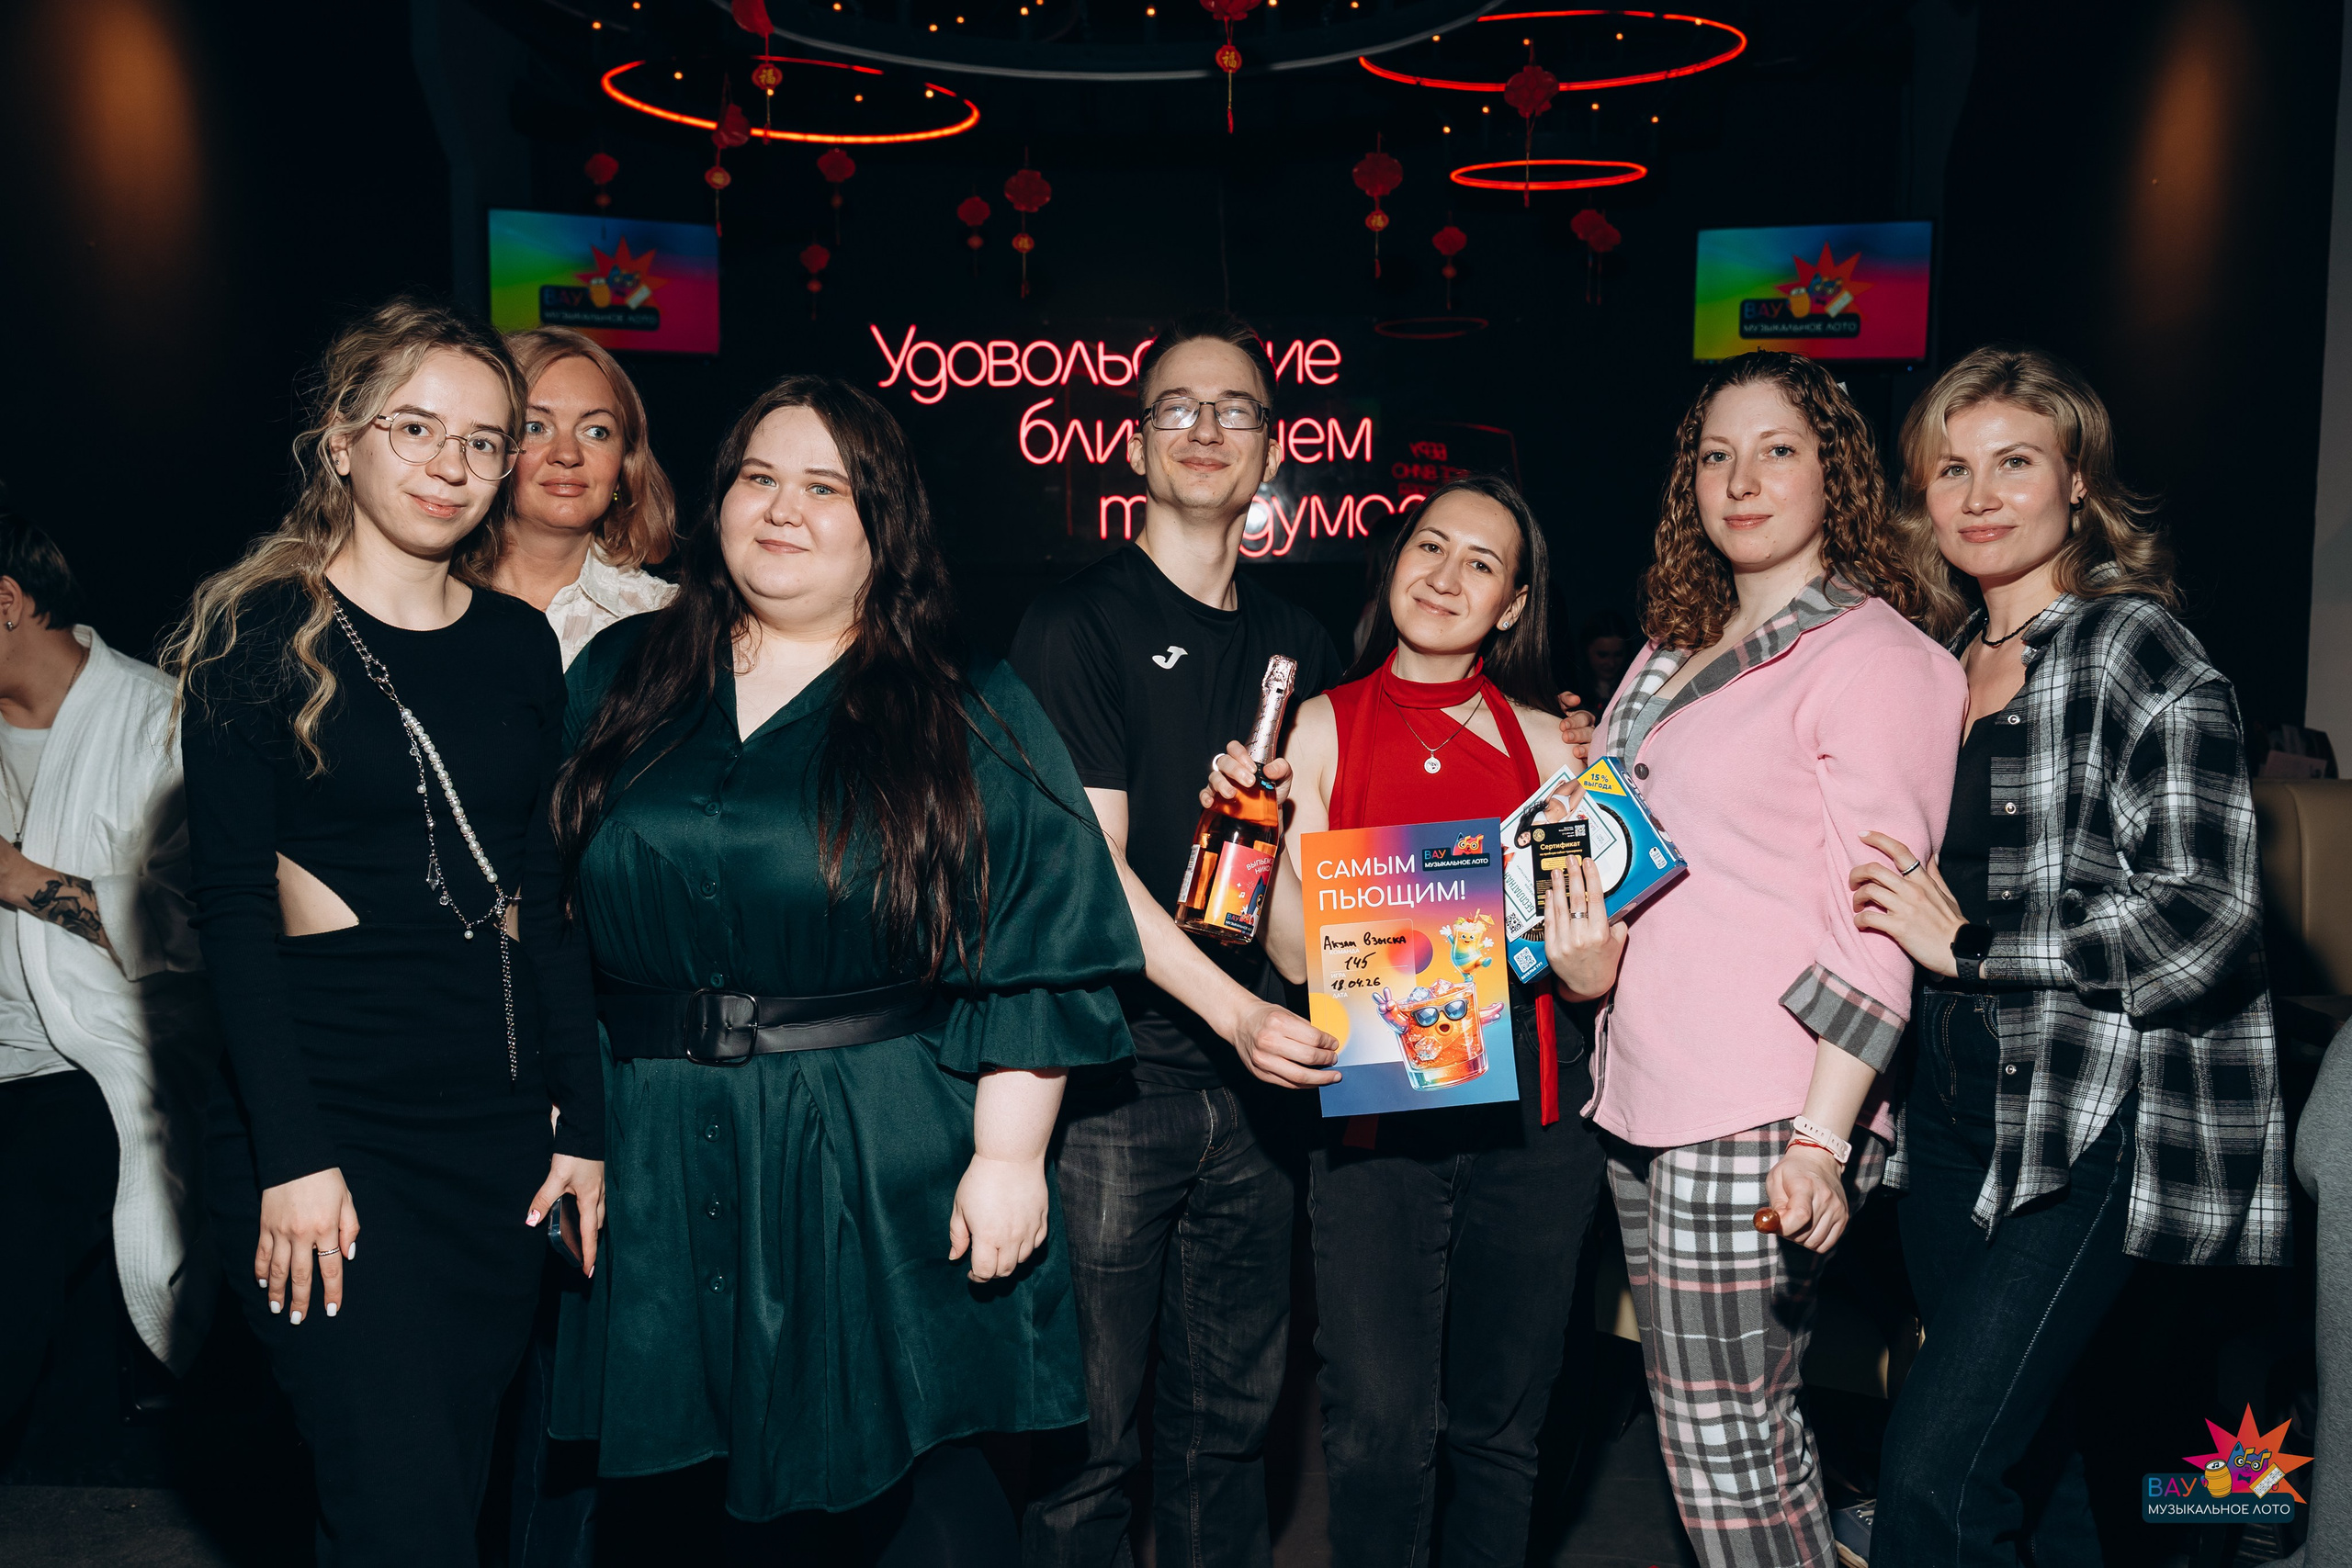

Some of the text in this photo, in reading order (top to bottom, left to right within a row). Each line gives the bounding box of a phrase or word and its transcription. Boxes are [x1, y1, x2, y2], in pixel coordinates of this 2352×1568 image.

[1584, 781, 1611, 790] ВЫГОДА
[1540, 840, 1581, 852] Сертификат
[1424, 850, 1446, 860] ВАУ
[1317, 853, 1416, 880] САМЫМ
[1424, 859, 1471, 868] МУЗЫКАЛЬНОЕ
[1318, 879, 1466, 911] ПЬЮЩИМ!
[1504, 872, 1535, 913] БЕСПЛАТНАЯ
[1344, 952, 1376, 970] 145
